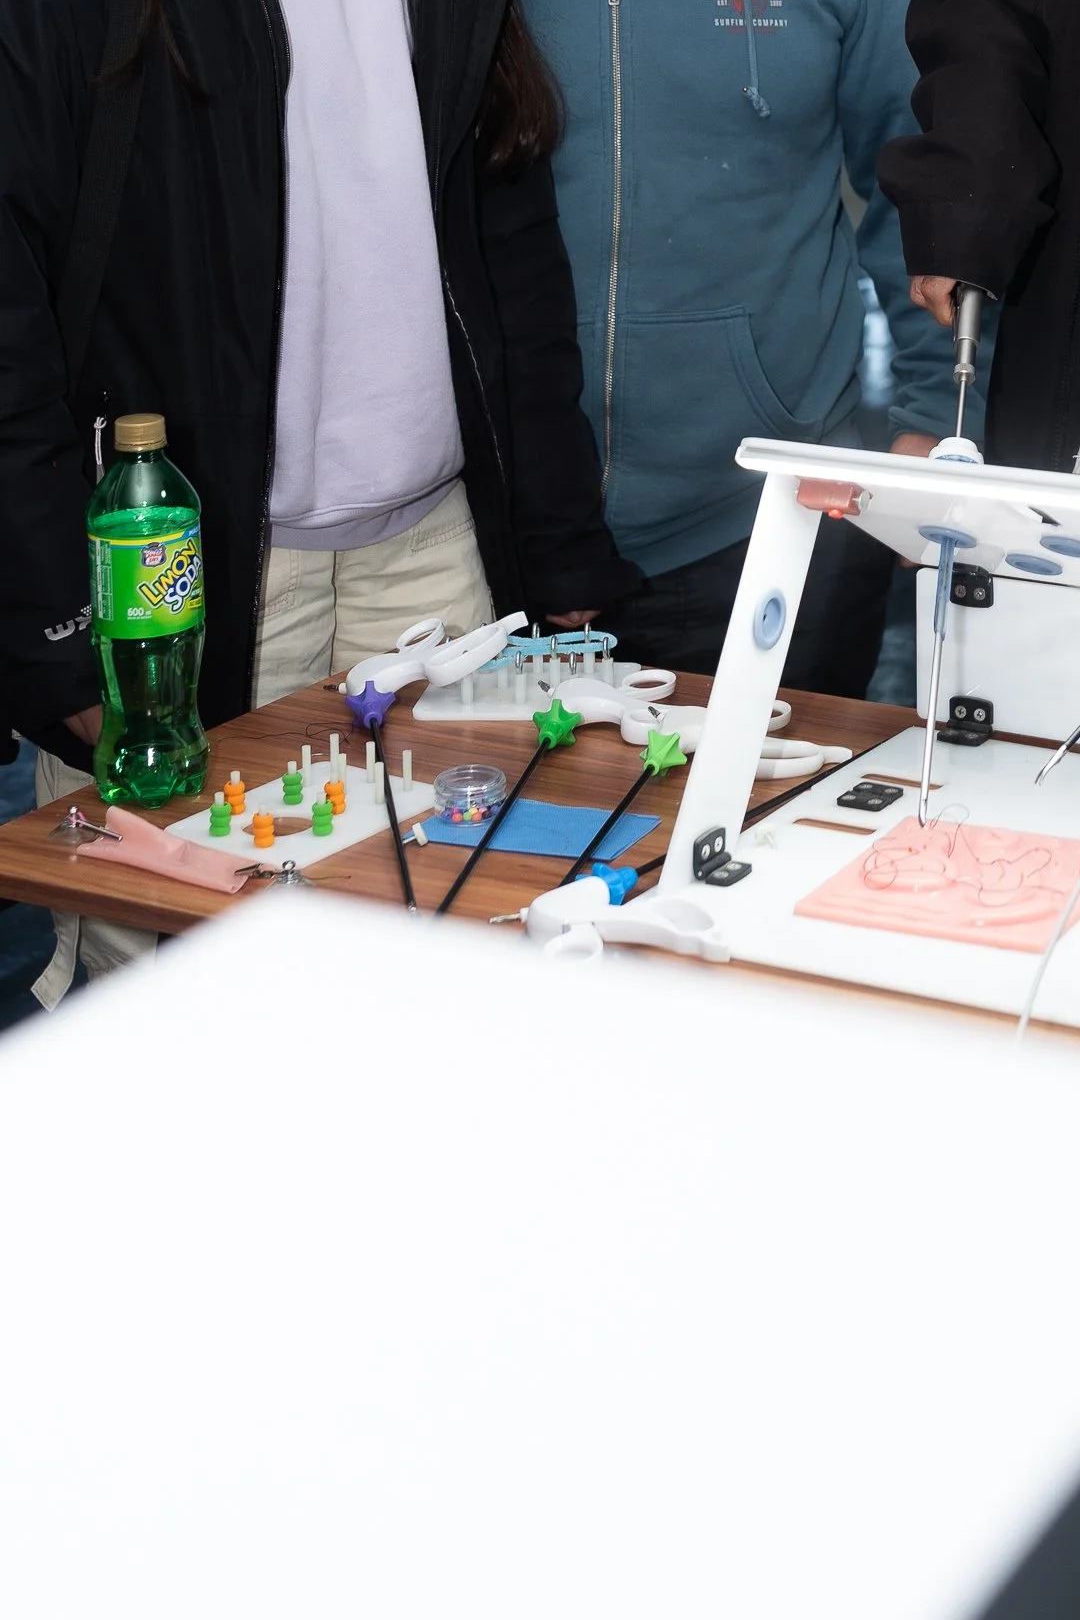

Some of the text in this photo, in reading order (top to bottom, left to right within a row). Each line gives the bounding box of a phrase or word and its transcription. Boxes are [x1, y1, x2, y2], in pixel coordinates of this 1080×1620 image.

[714, 18, 788, 27] SURFIN COMPANY
[138, 540, 197, 605] LIMÓN
[164, 555, 201, 612] SODA
[127, 607, 145, 617] 600
